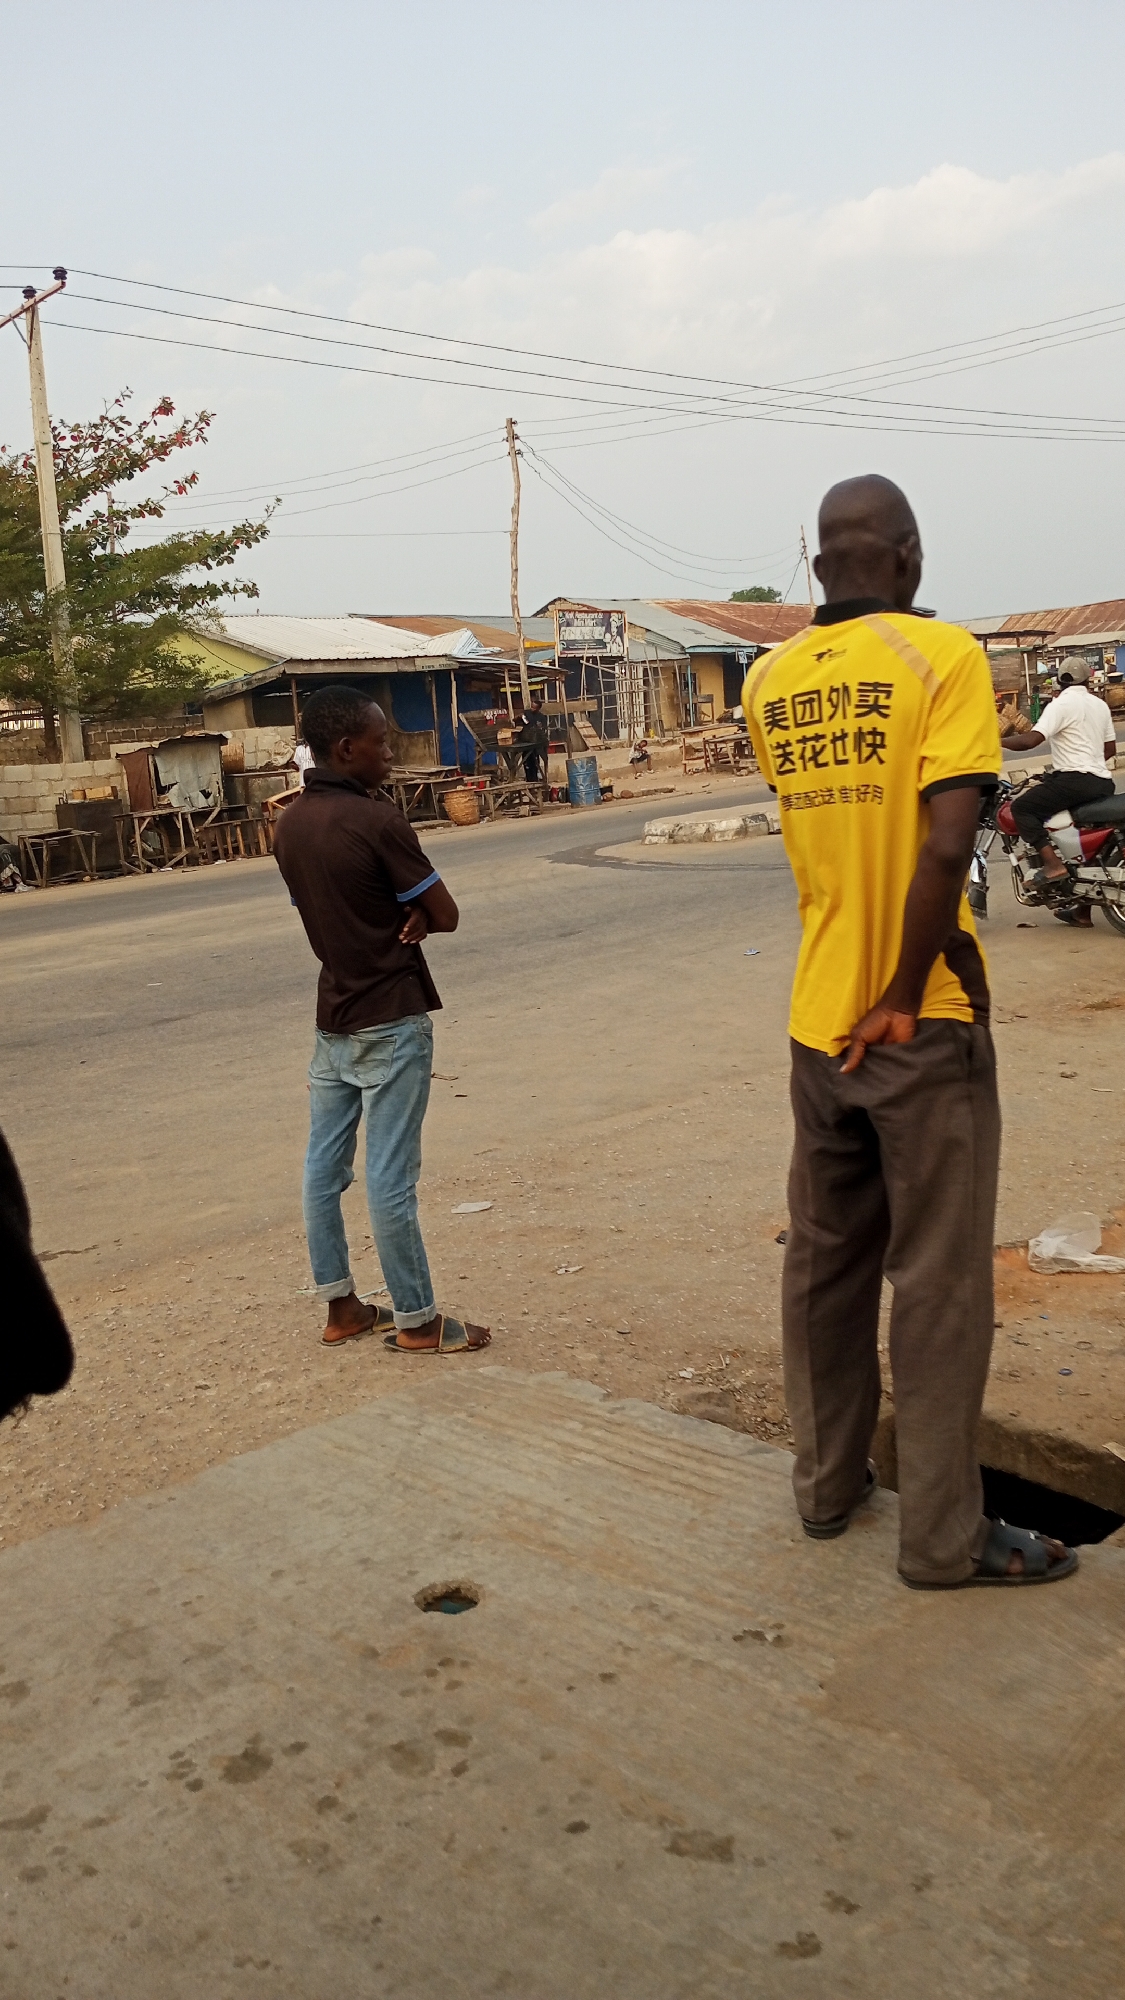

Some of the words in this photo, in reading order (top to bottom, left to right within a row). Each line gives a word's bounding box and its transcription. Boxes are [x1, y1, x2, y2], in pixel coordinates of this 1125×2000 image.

[763, 682, 894, 736] 美团外卖
[769, 726, 887, 776] 送花也快
